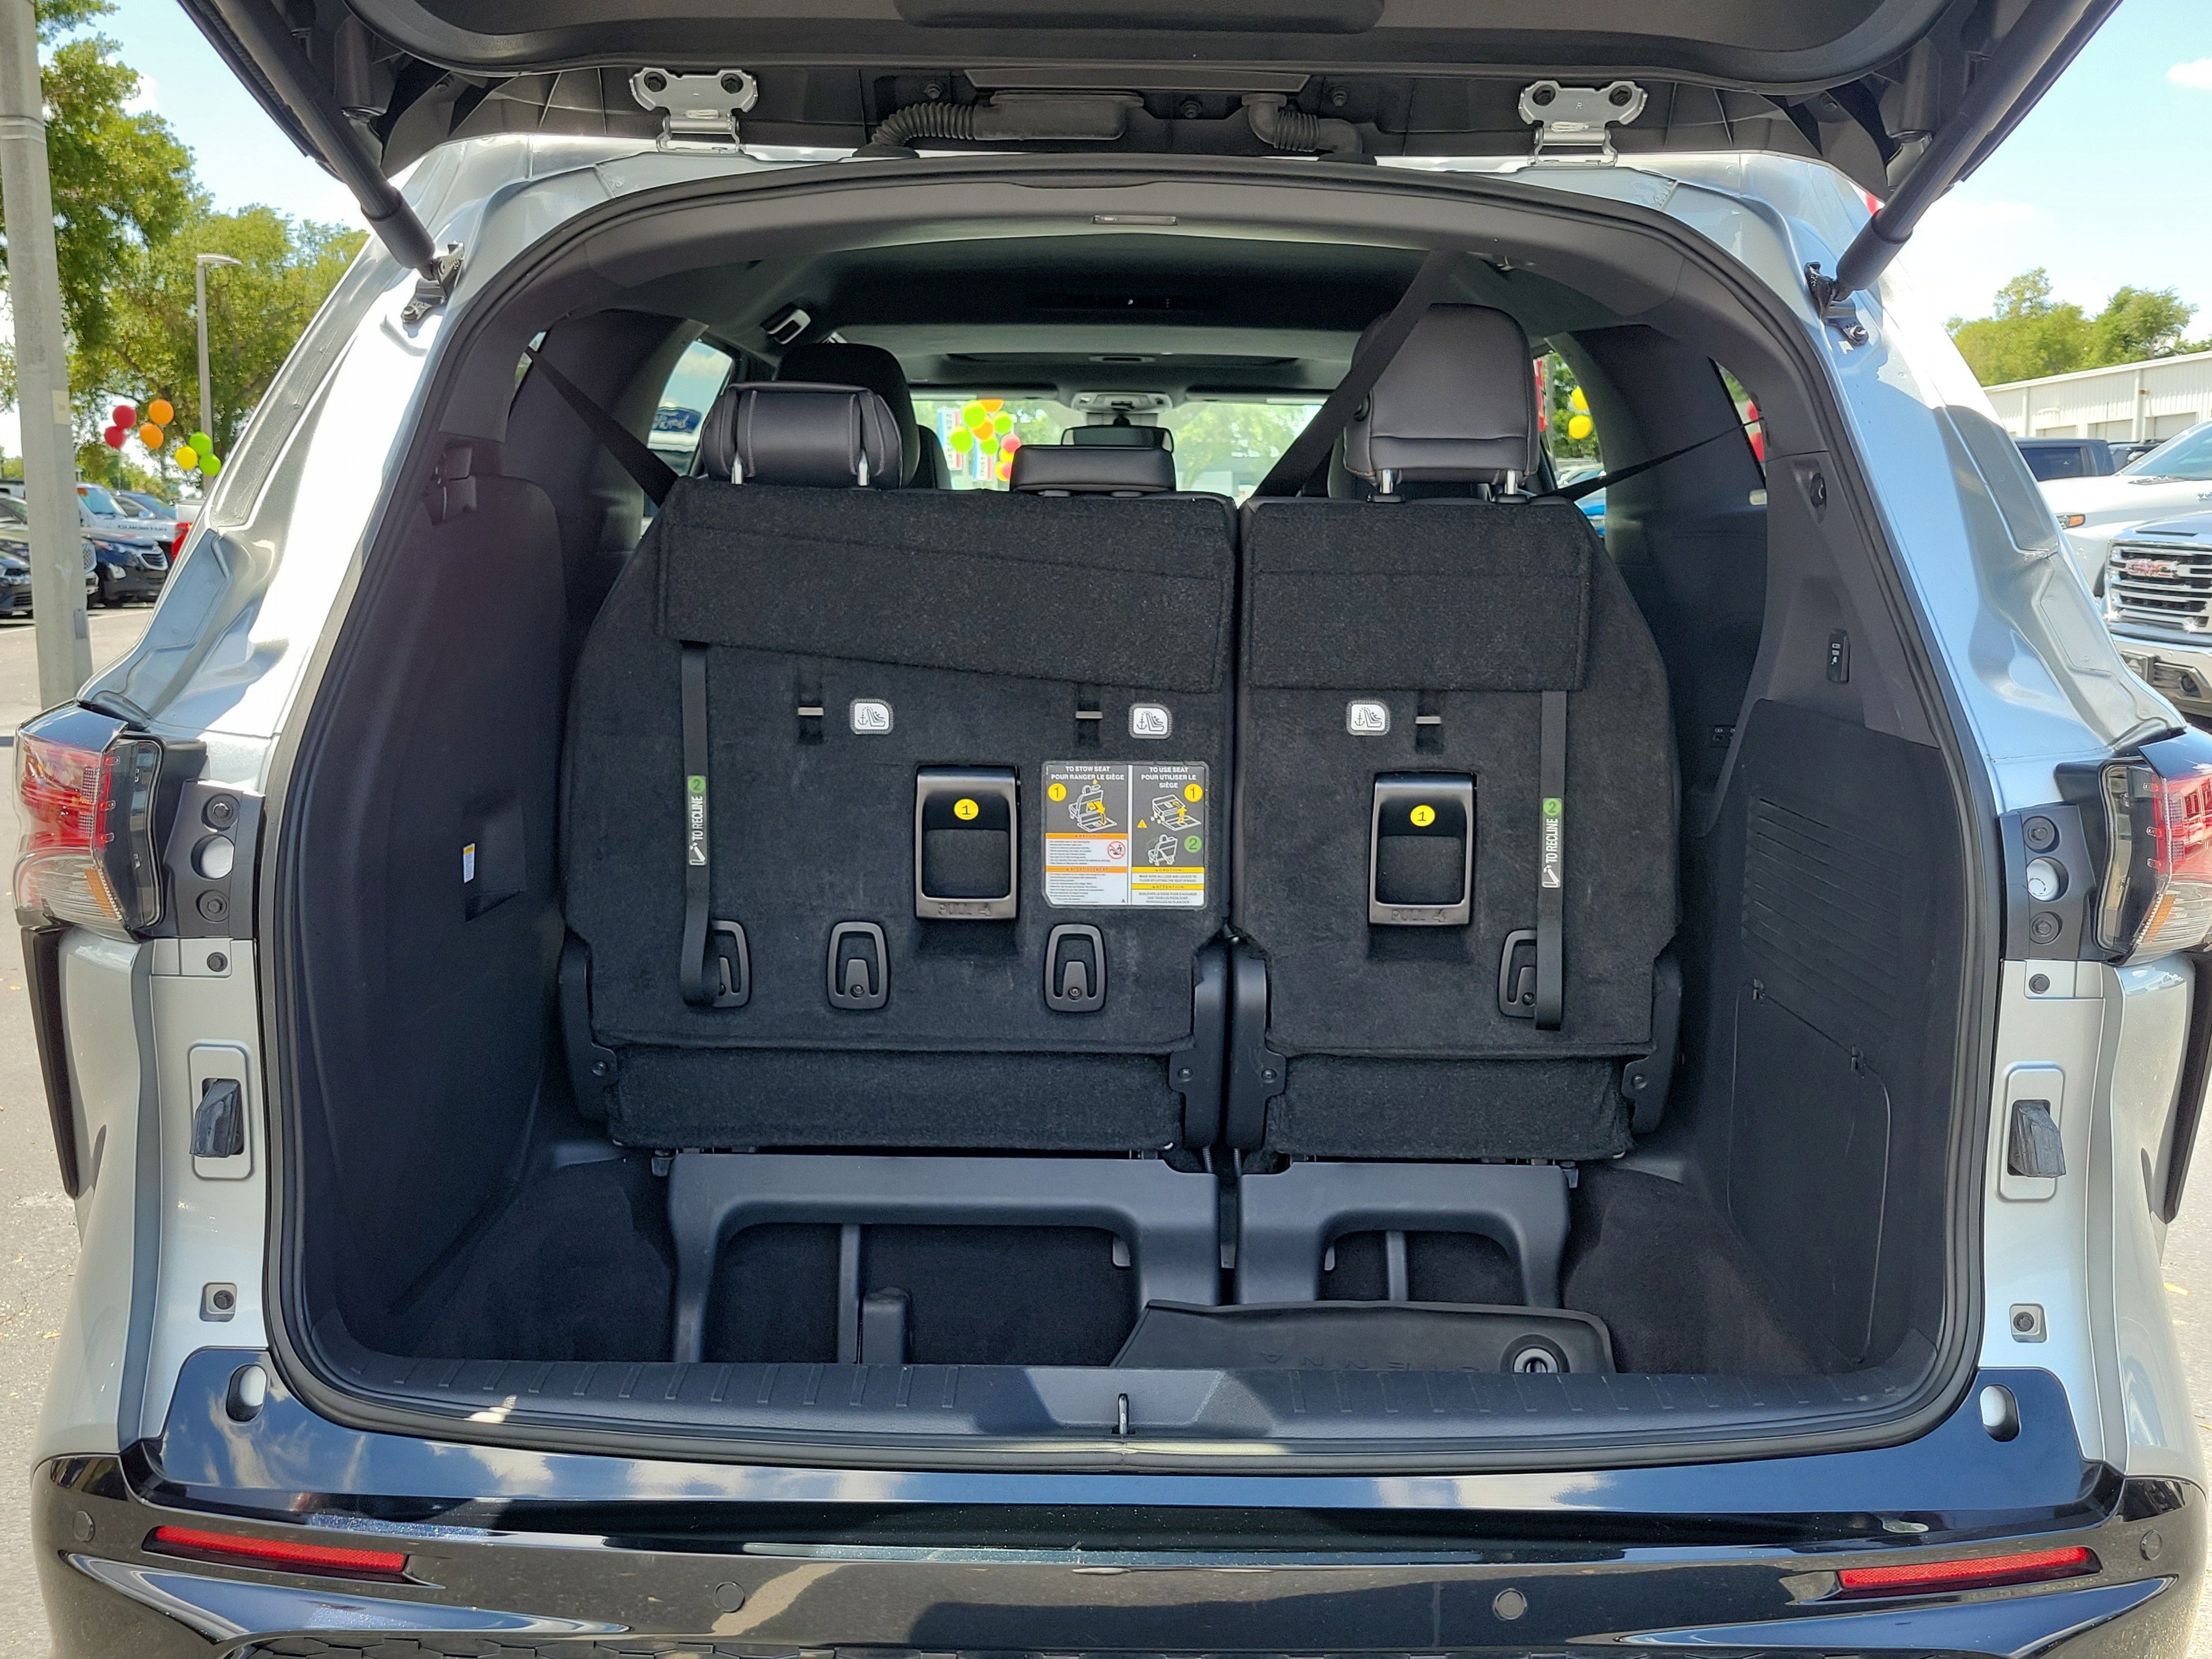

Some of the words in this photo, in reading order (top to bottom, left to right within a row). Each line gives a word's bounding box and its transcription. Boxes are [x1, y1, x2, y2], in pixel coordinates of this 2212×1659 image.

[693, 778, 701, 791] 2
[1054, 786, 1059, 798] 1
[1190, 787, 1195, 799] 1
[692, 795, 703, 829] RECLINE
[962, 804, 971, 815] 1
[1548, 801, 1556, 813] 2
[1417, 811, 1427, 822] 1
[692, 830, 703, 841] TO
[1545, 817, 1559, 851] RECLINE
[1189, 837, 1197, 850] 2
[1545, 853, 1558, 864] TO
[938, 902, 973, 916] PULL
[1391, 909, 1425, 922] PULL
